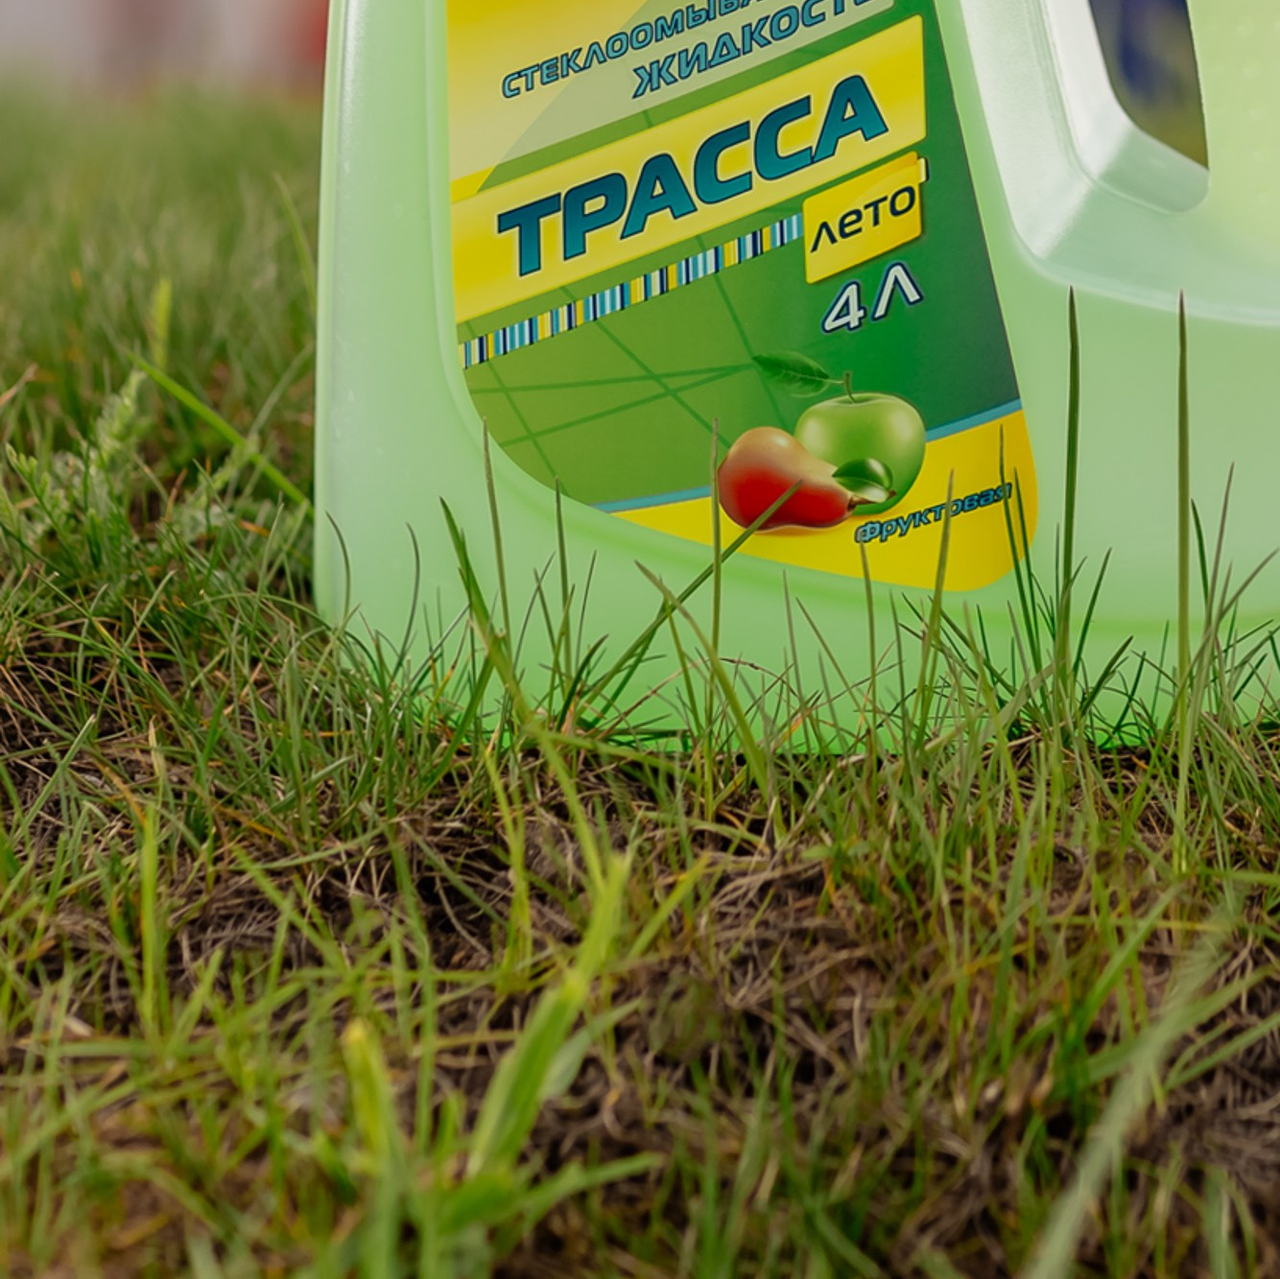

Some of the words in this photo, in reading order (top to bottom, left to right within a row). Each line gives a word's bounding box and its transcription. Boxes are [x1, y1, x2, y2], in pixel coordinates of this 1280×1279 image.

[497, 74, 889, 277] ТРАССА
[810, 185, 916, 254] лето
[821, 280, 865, 334] 4
